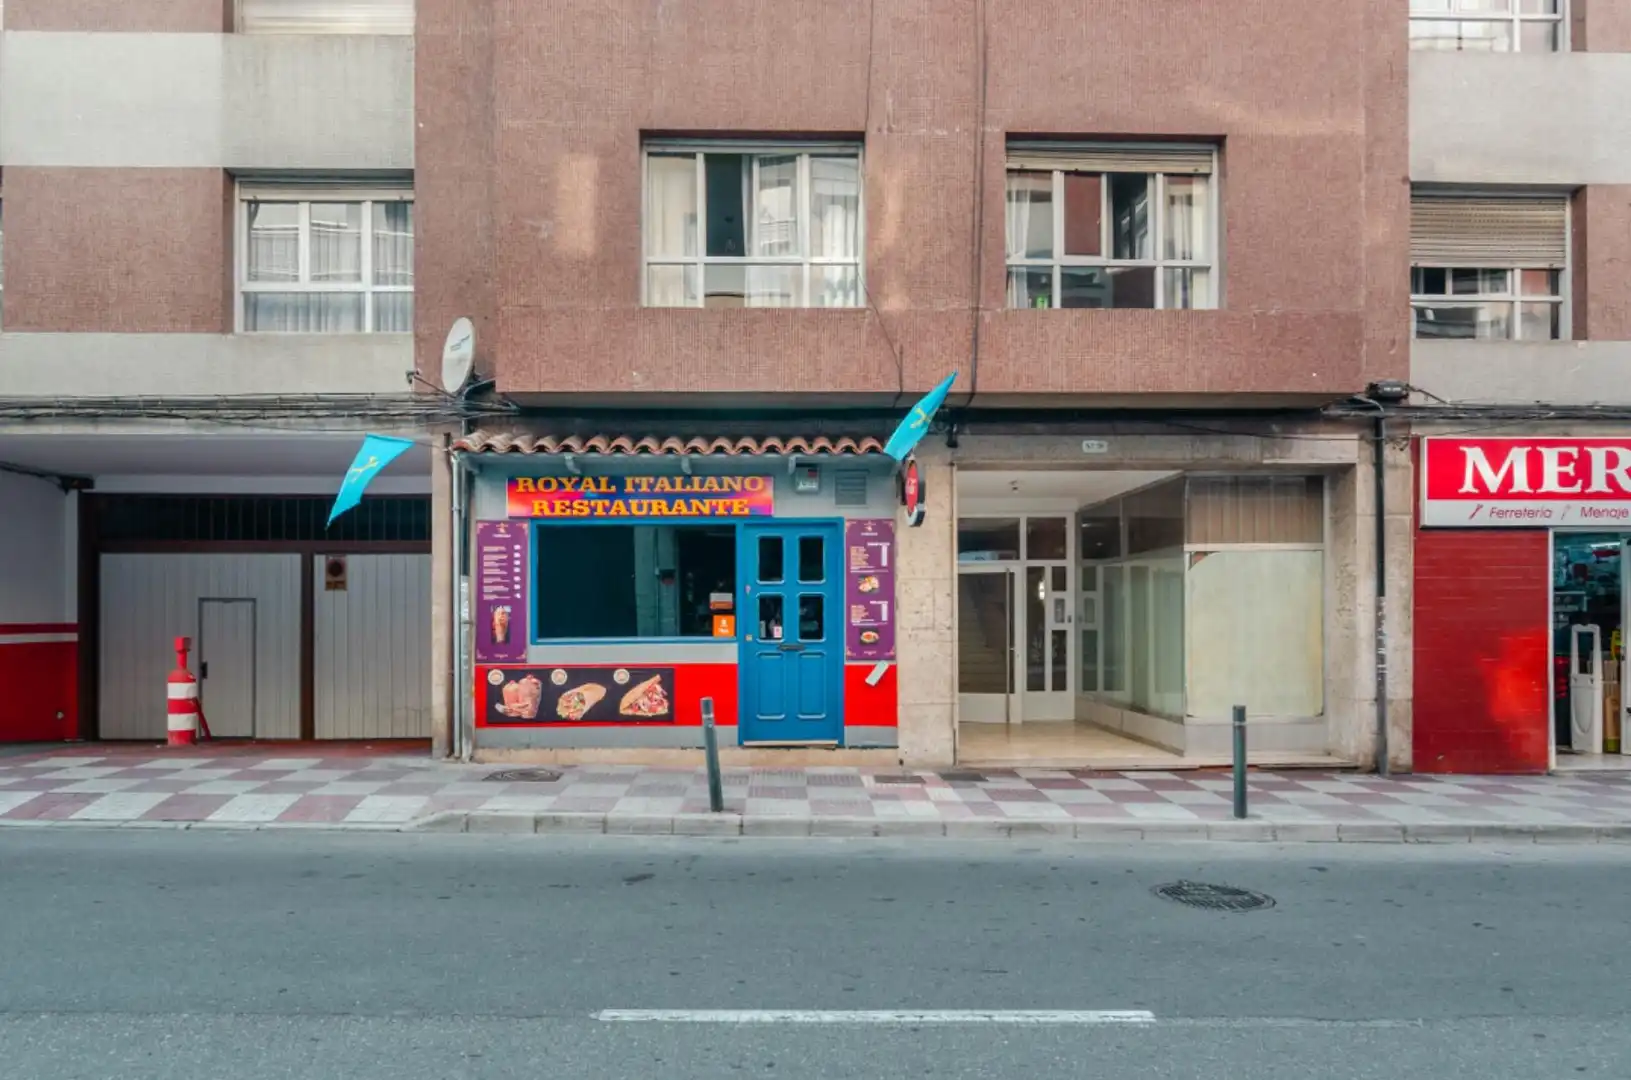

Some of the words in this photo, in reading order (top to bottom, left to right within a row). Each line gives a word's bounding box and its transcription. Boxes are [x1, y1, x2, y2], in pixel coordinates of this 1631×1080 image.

[1458, 445, 1631, 494] MER
[516, 476, 616, 493] ROYAL
[624, 476, 765, 493] ITALIANO
[531, 499, 750, 516] RESTAURANTE
[1580, 506, 1630, 520] Menaje
